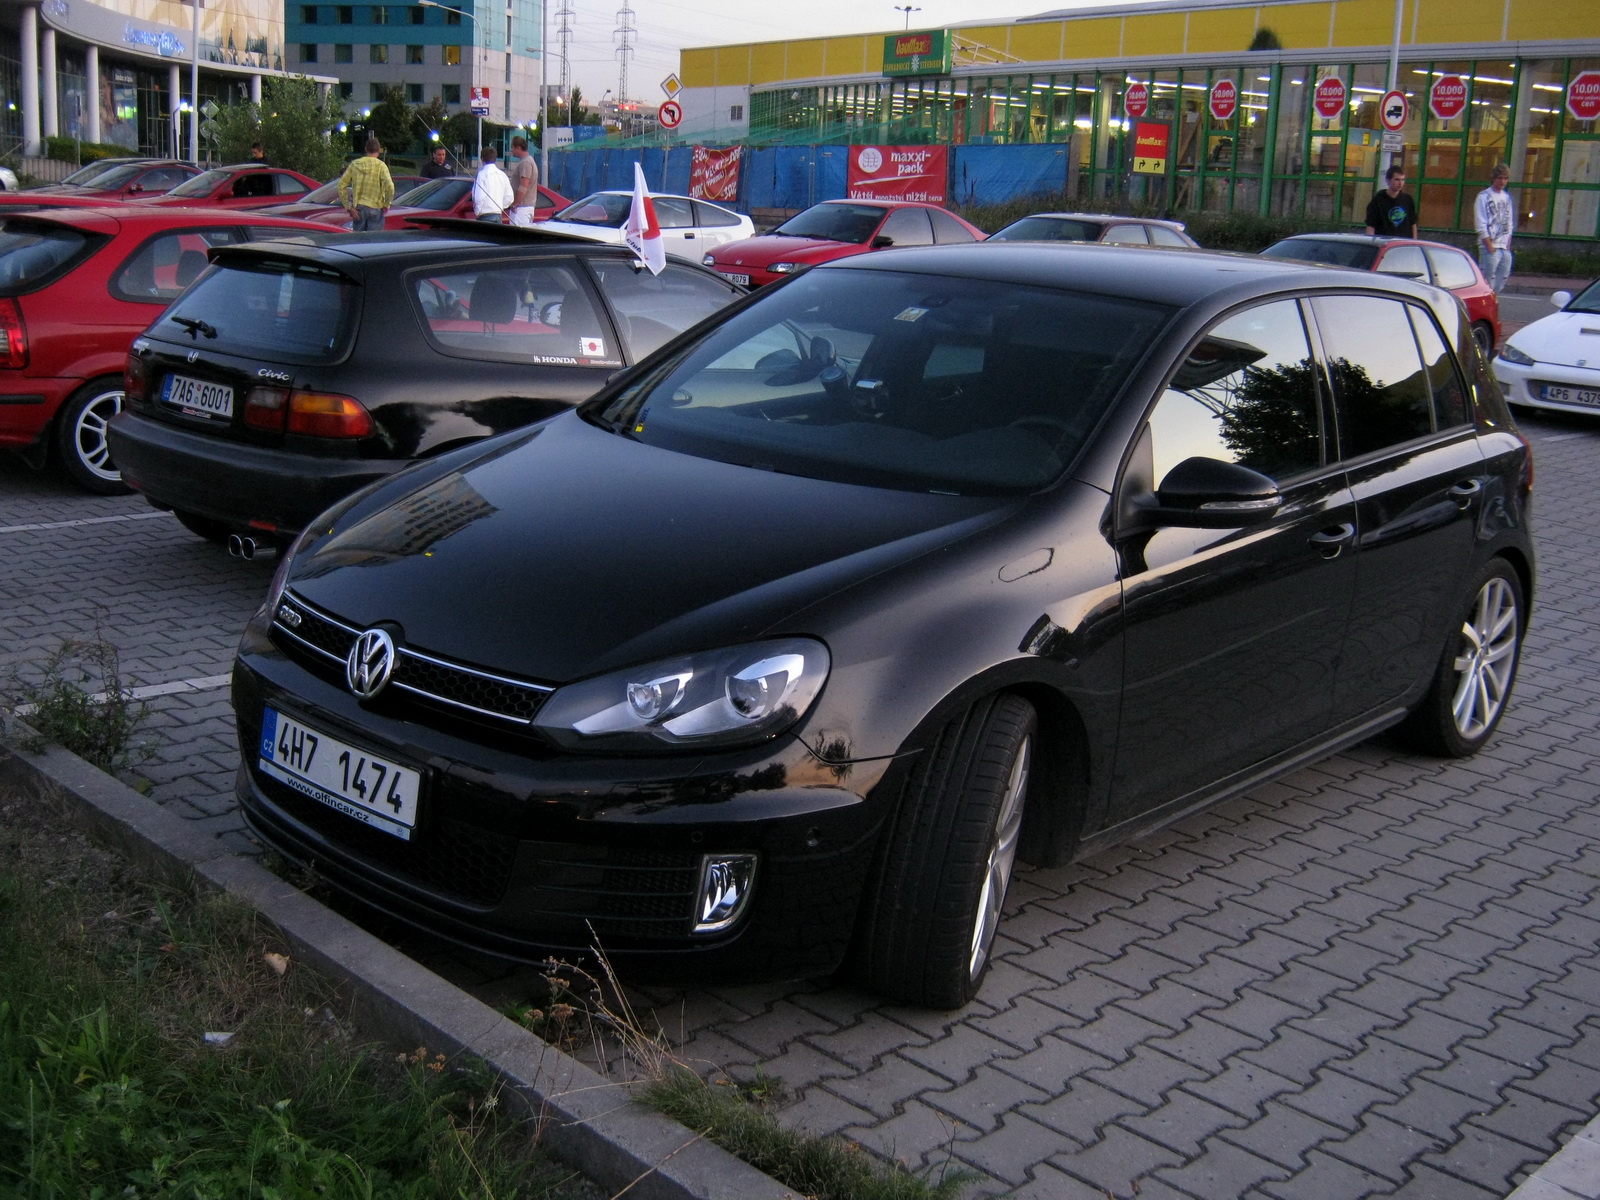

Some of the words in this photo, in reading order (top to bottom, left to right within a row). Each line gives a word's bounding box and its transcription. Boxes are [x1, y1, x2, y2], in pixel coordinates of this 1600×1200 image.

[1214, 90, 1234, 98] 10.000
[1319, 87, 1342, 96] 10.000
[1436, 85, 1463, 95] 10.000
[1575, 84, 1600, 93] 10.00
[891, 150, 931, 162] maxxi-
[898, 162, 924, 176] pack
[626, 238, 641, 253] club
[541, 356, 578, 365] HONDA
[258, 368, 290, 381] Civic
[172, 378, 194, 403] 7A6
[200, 385, 231, 413] 6001
[1549, 388, 1569, 400] 4P6
[263, 738, 273, 753] CZ
[278, 722, 319, 773] 4H7
[338, 750, 402, 814] 1474
[286, 777, 370, 823] www.olfincar.cz
